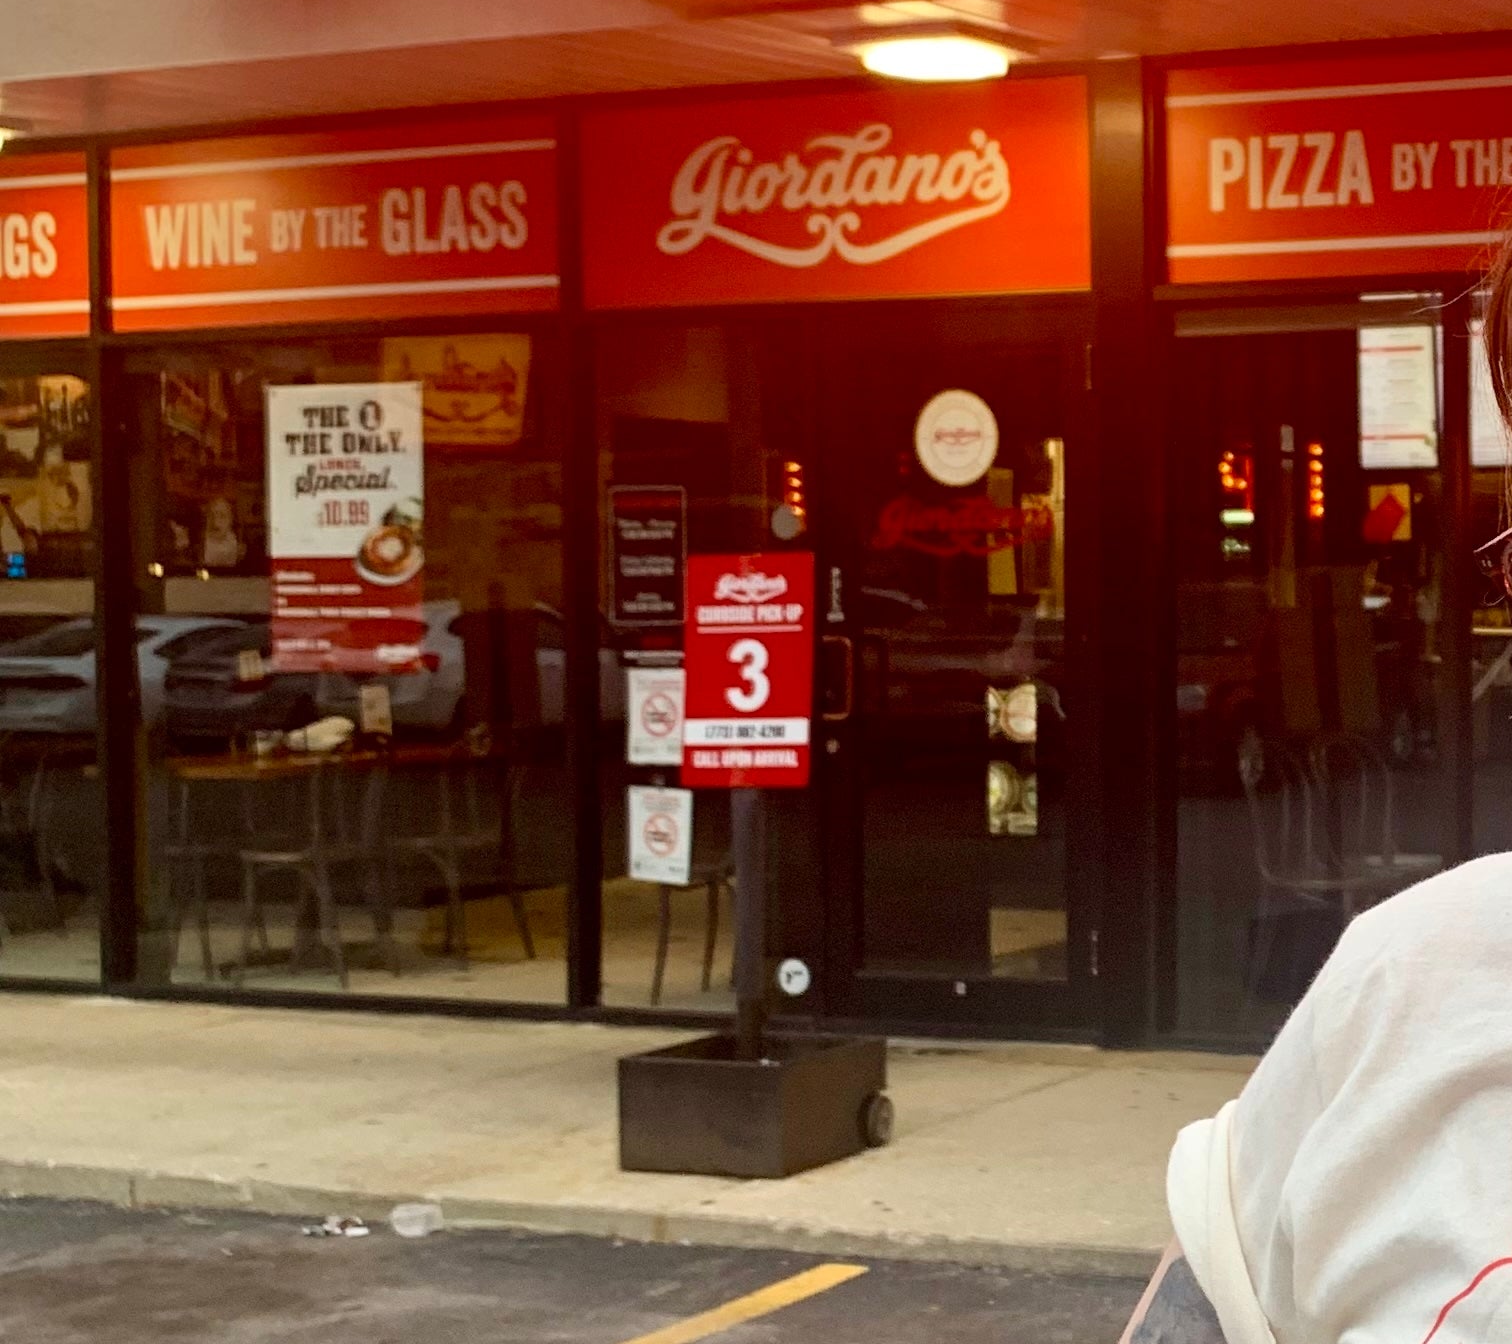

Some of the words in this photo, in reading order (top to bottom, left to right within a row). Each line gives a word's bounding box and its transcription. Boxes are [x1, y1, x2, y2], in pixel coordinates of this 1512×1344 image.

[656, 124, 1011, 268] Giordano's
[1209, 131, 1375, 213] PIZZA
[1391, 142, 1439, 192] BY
[0, 211, 58, 279] GS
[145, 199, 258, 270] WINE
[271, 209, 307, 252] BY
[313, 205, 368, 249] THE
[380, 181, 530, 256] GLASS
[285, 432, 333, 456] THE
[302, 405, 350, 428] THE
[725, 638, 770, 712] 3
